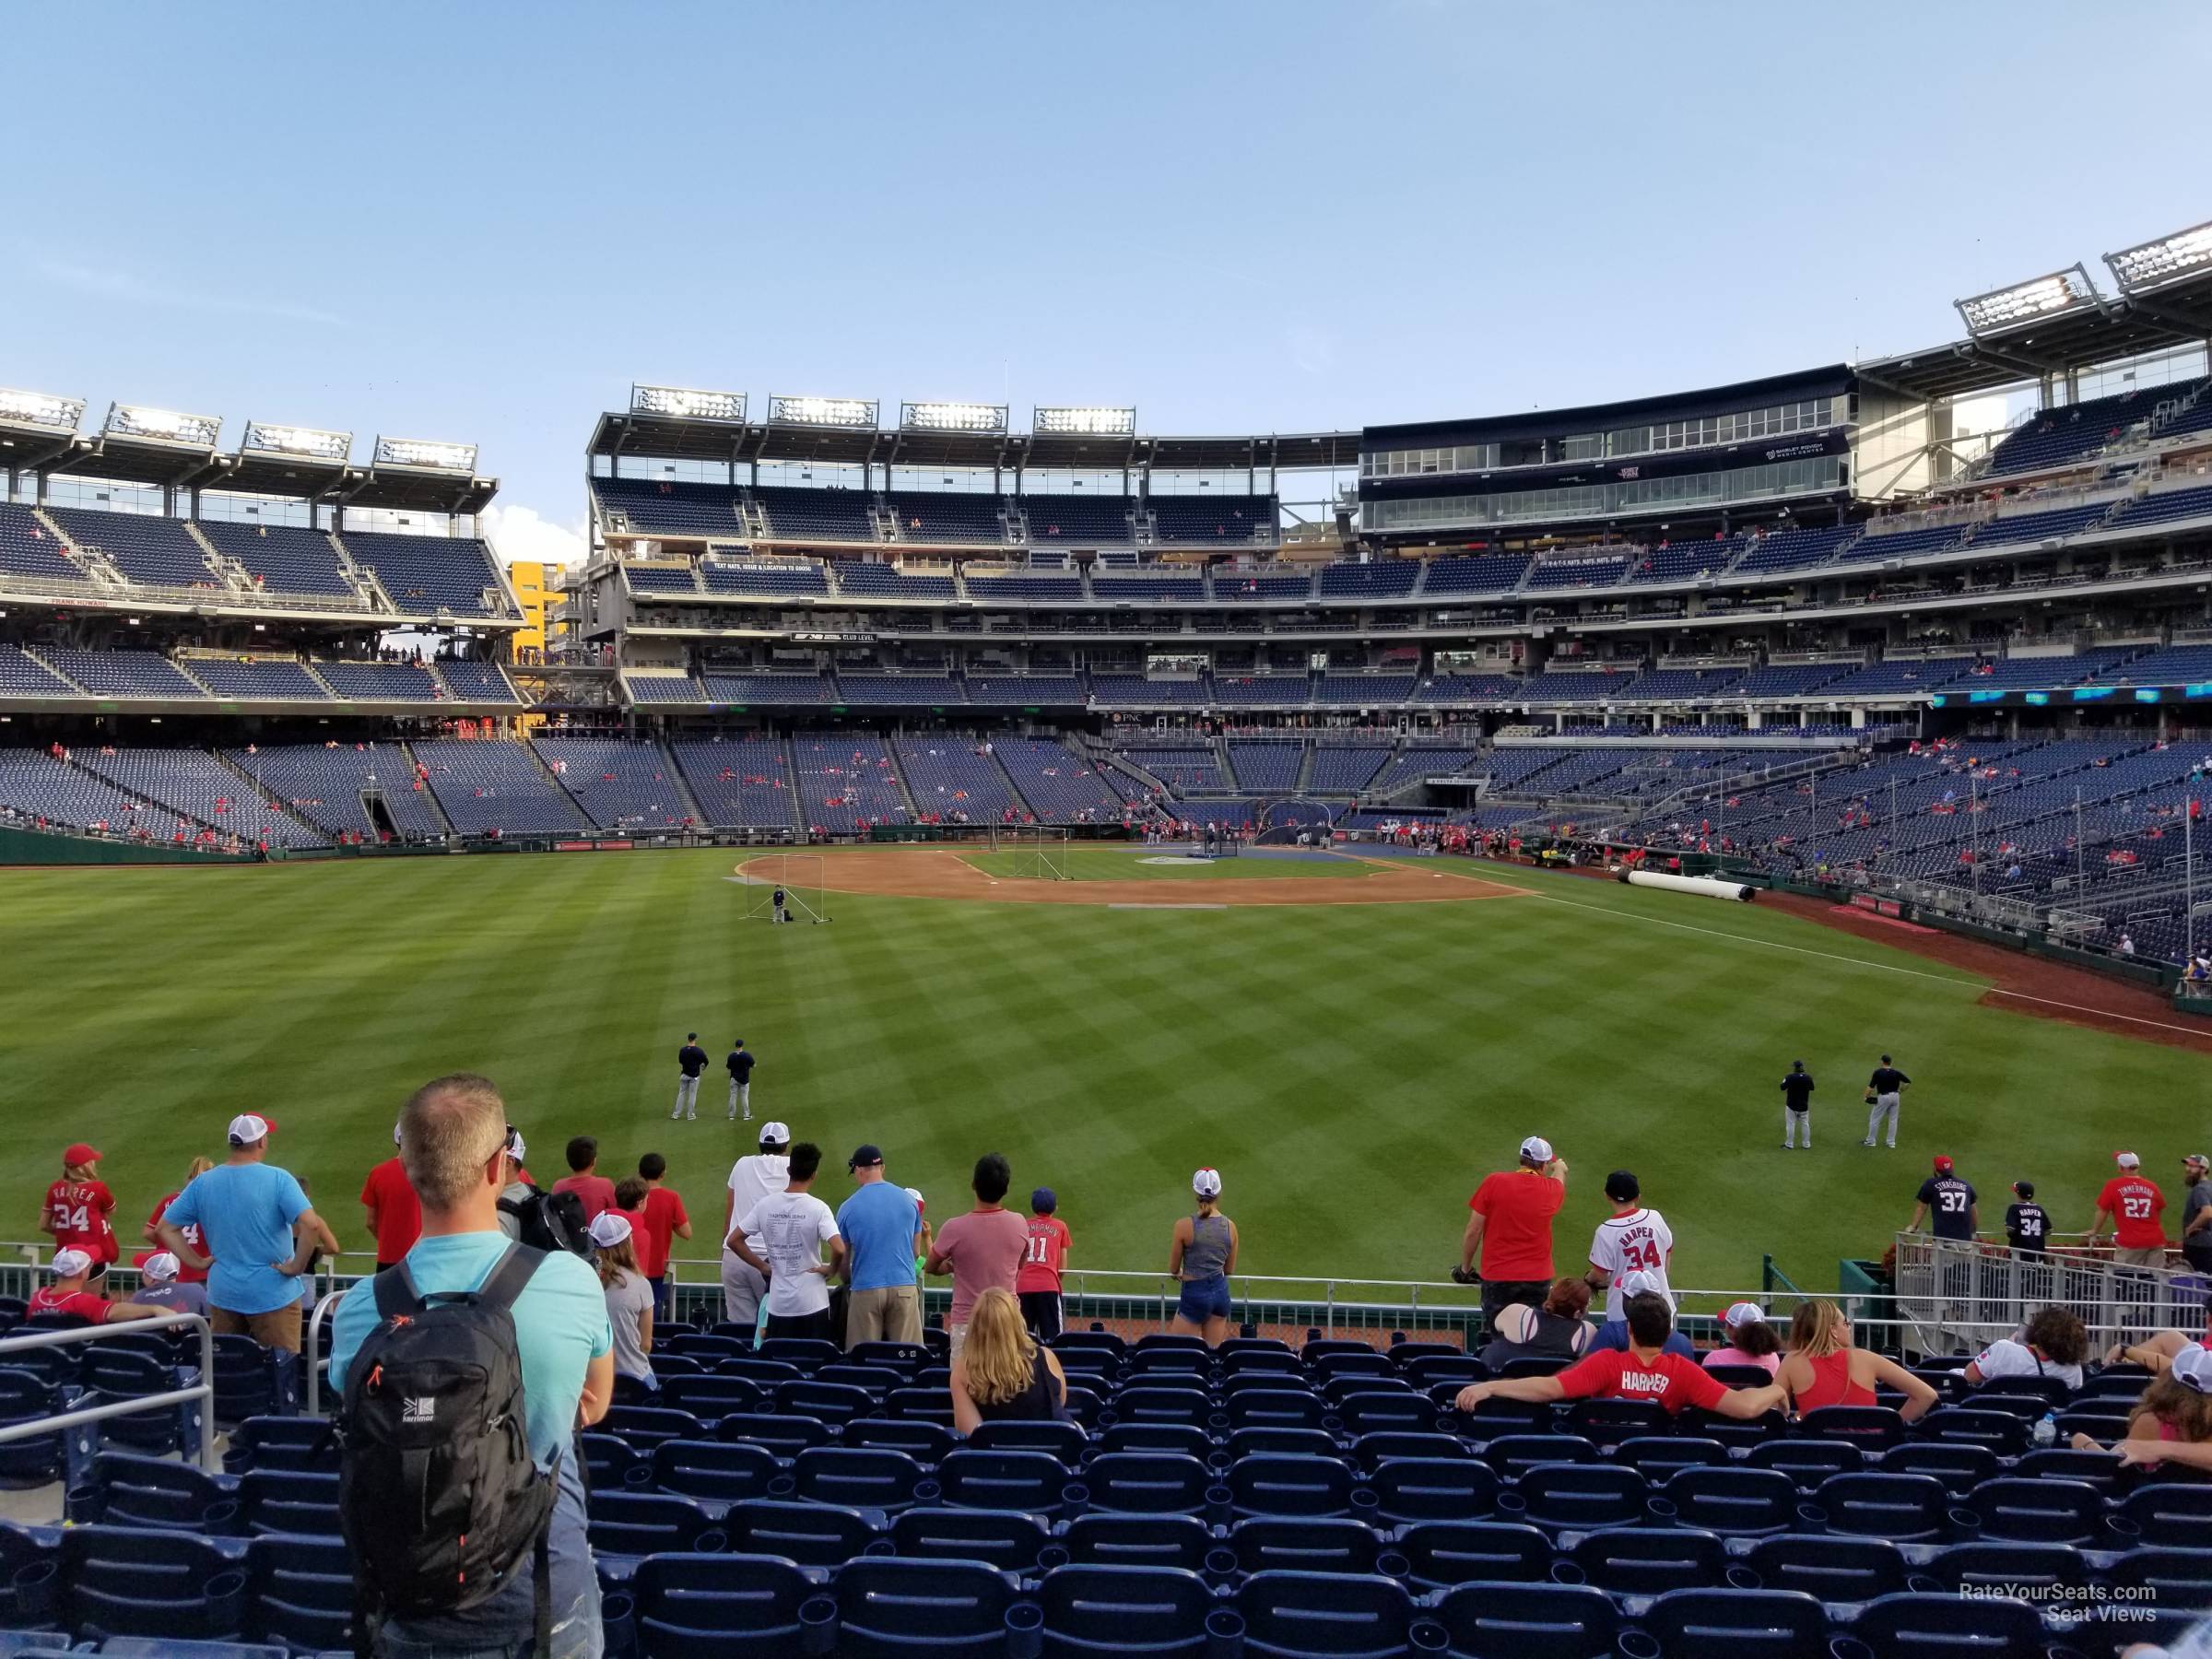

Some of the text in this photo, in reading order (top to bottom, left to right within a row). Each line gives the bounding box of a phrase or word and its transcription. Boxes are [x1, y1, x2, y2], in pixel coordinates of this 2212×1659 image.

[1123, 713, 1143, 722] PNC
[1460, 712, 1480, 721] PNC
[1939, 1192, 1968, 1212] 37
[2124, 1197, 2152, 1218] 27
[53, 1204, 89, 1232] 34
[2018, 1208, 2042, 1218] HARPER
[1618, 1227, 1654, 1248] HARPER
[2020, 1218, 2041, 1236] 34
[1027, 1237, 1047, 1263] 11
[1623, 1240, 1662, 1272] 34
[1621, 1371, 1670, 1394] HARPER
